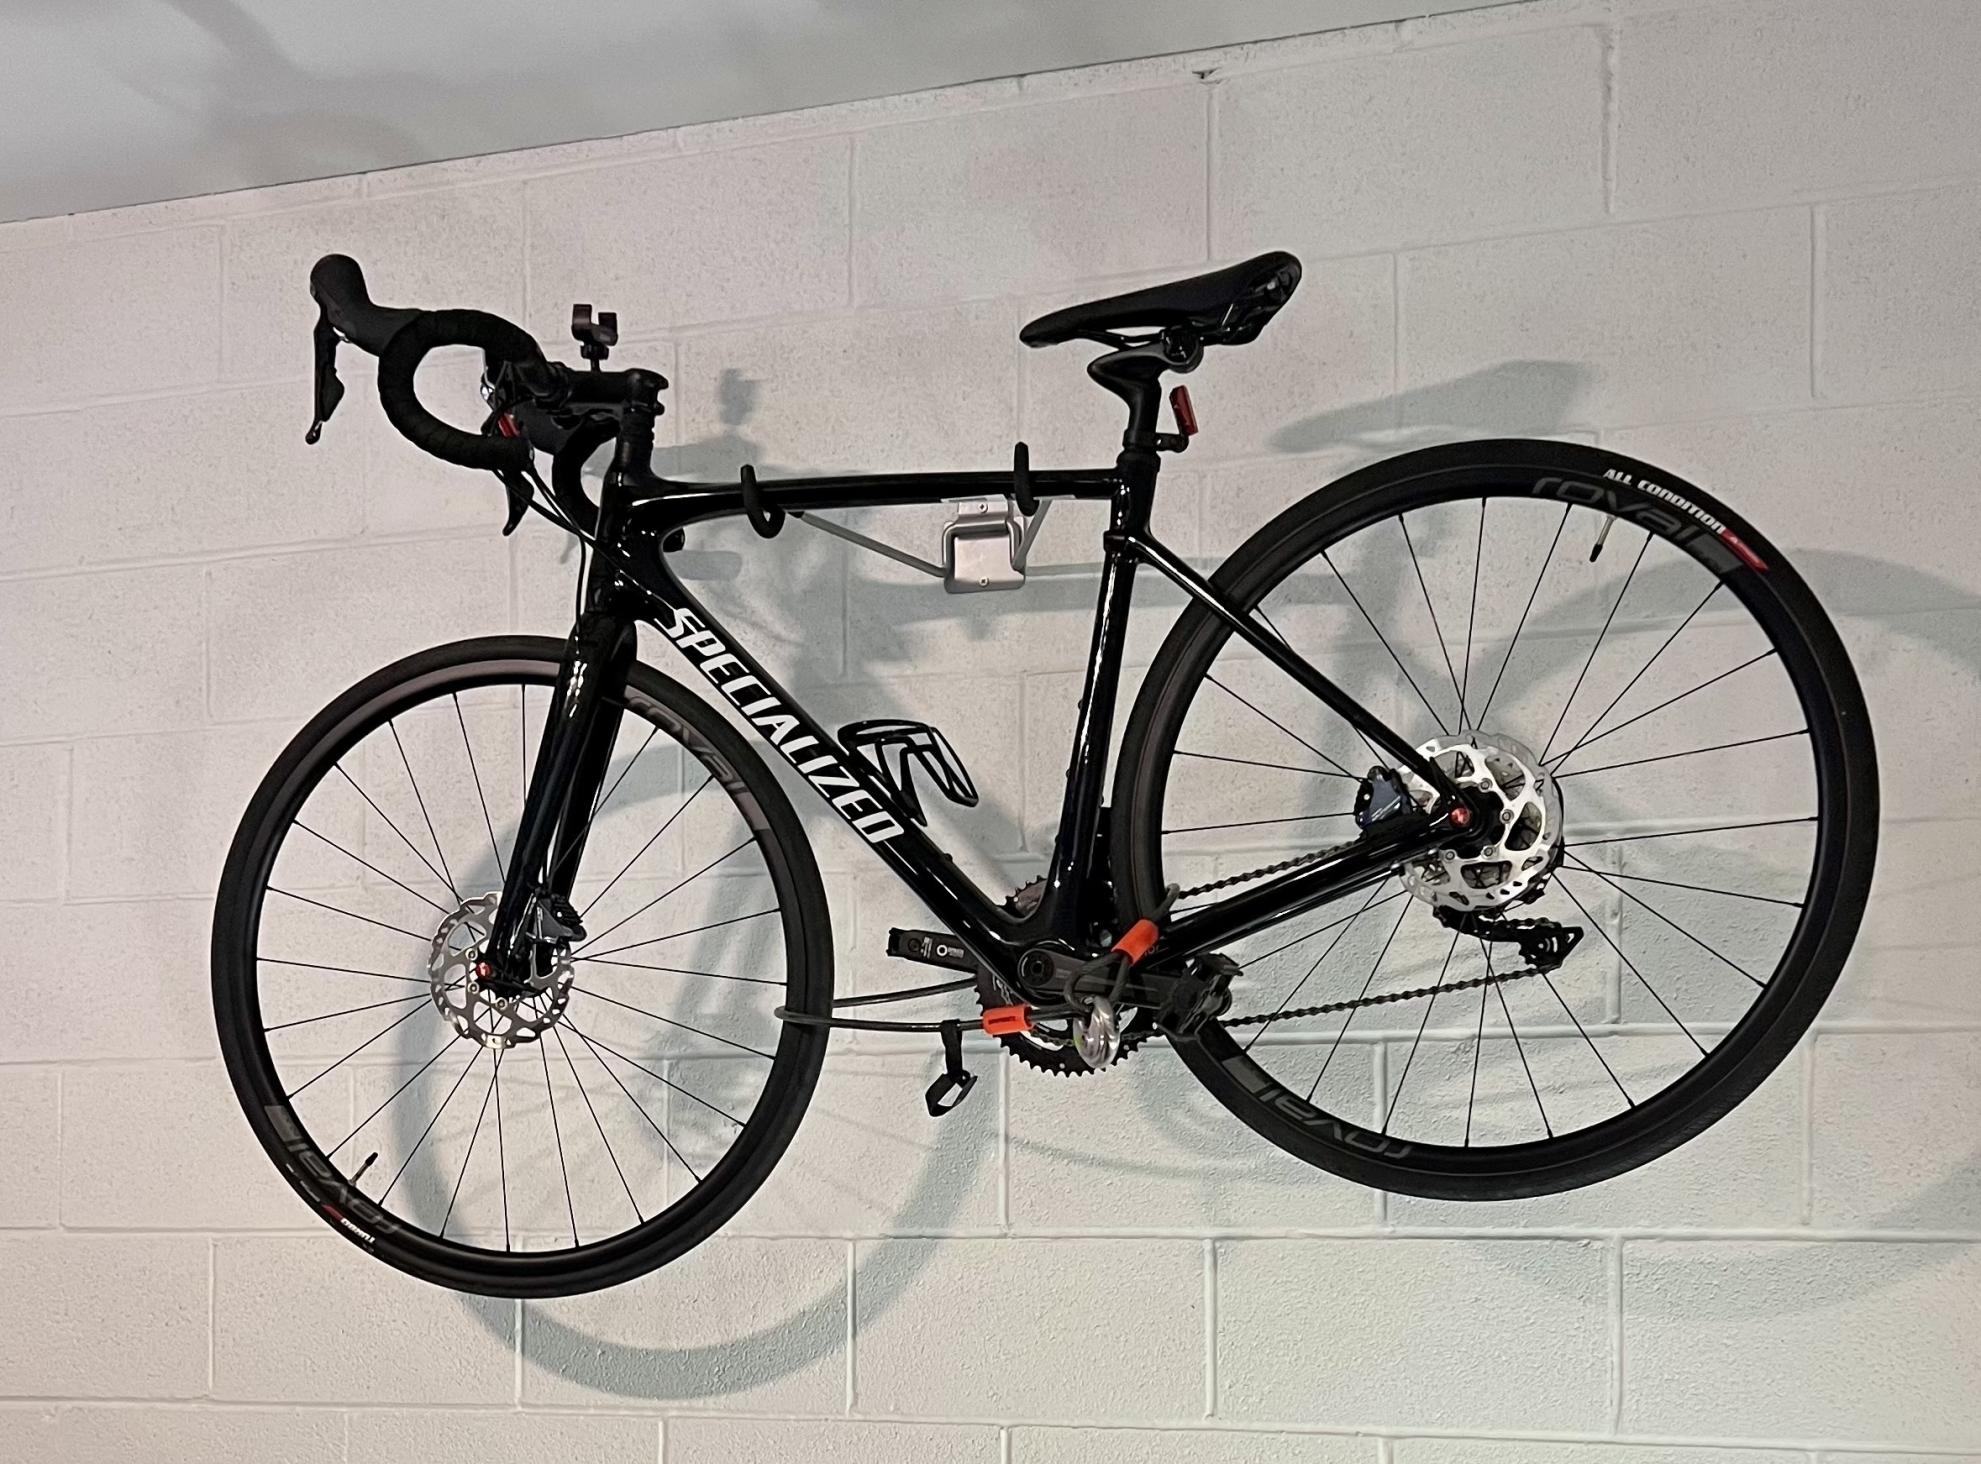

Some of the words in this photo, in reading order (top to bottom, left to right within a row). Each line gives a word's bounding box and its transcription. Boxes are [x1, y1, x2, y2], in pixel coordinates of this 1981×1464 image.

[1603, 468, 1632, 486] ALL
[1637, 479, 1726, 535] CONDITION
[653, 607, 905, 843] SPECIALIZED
